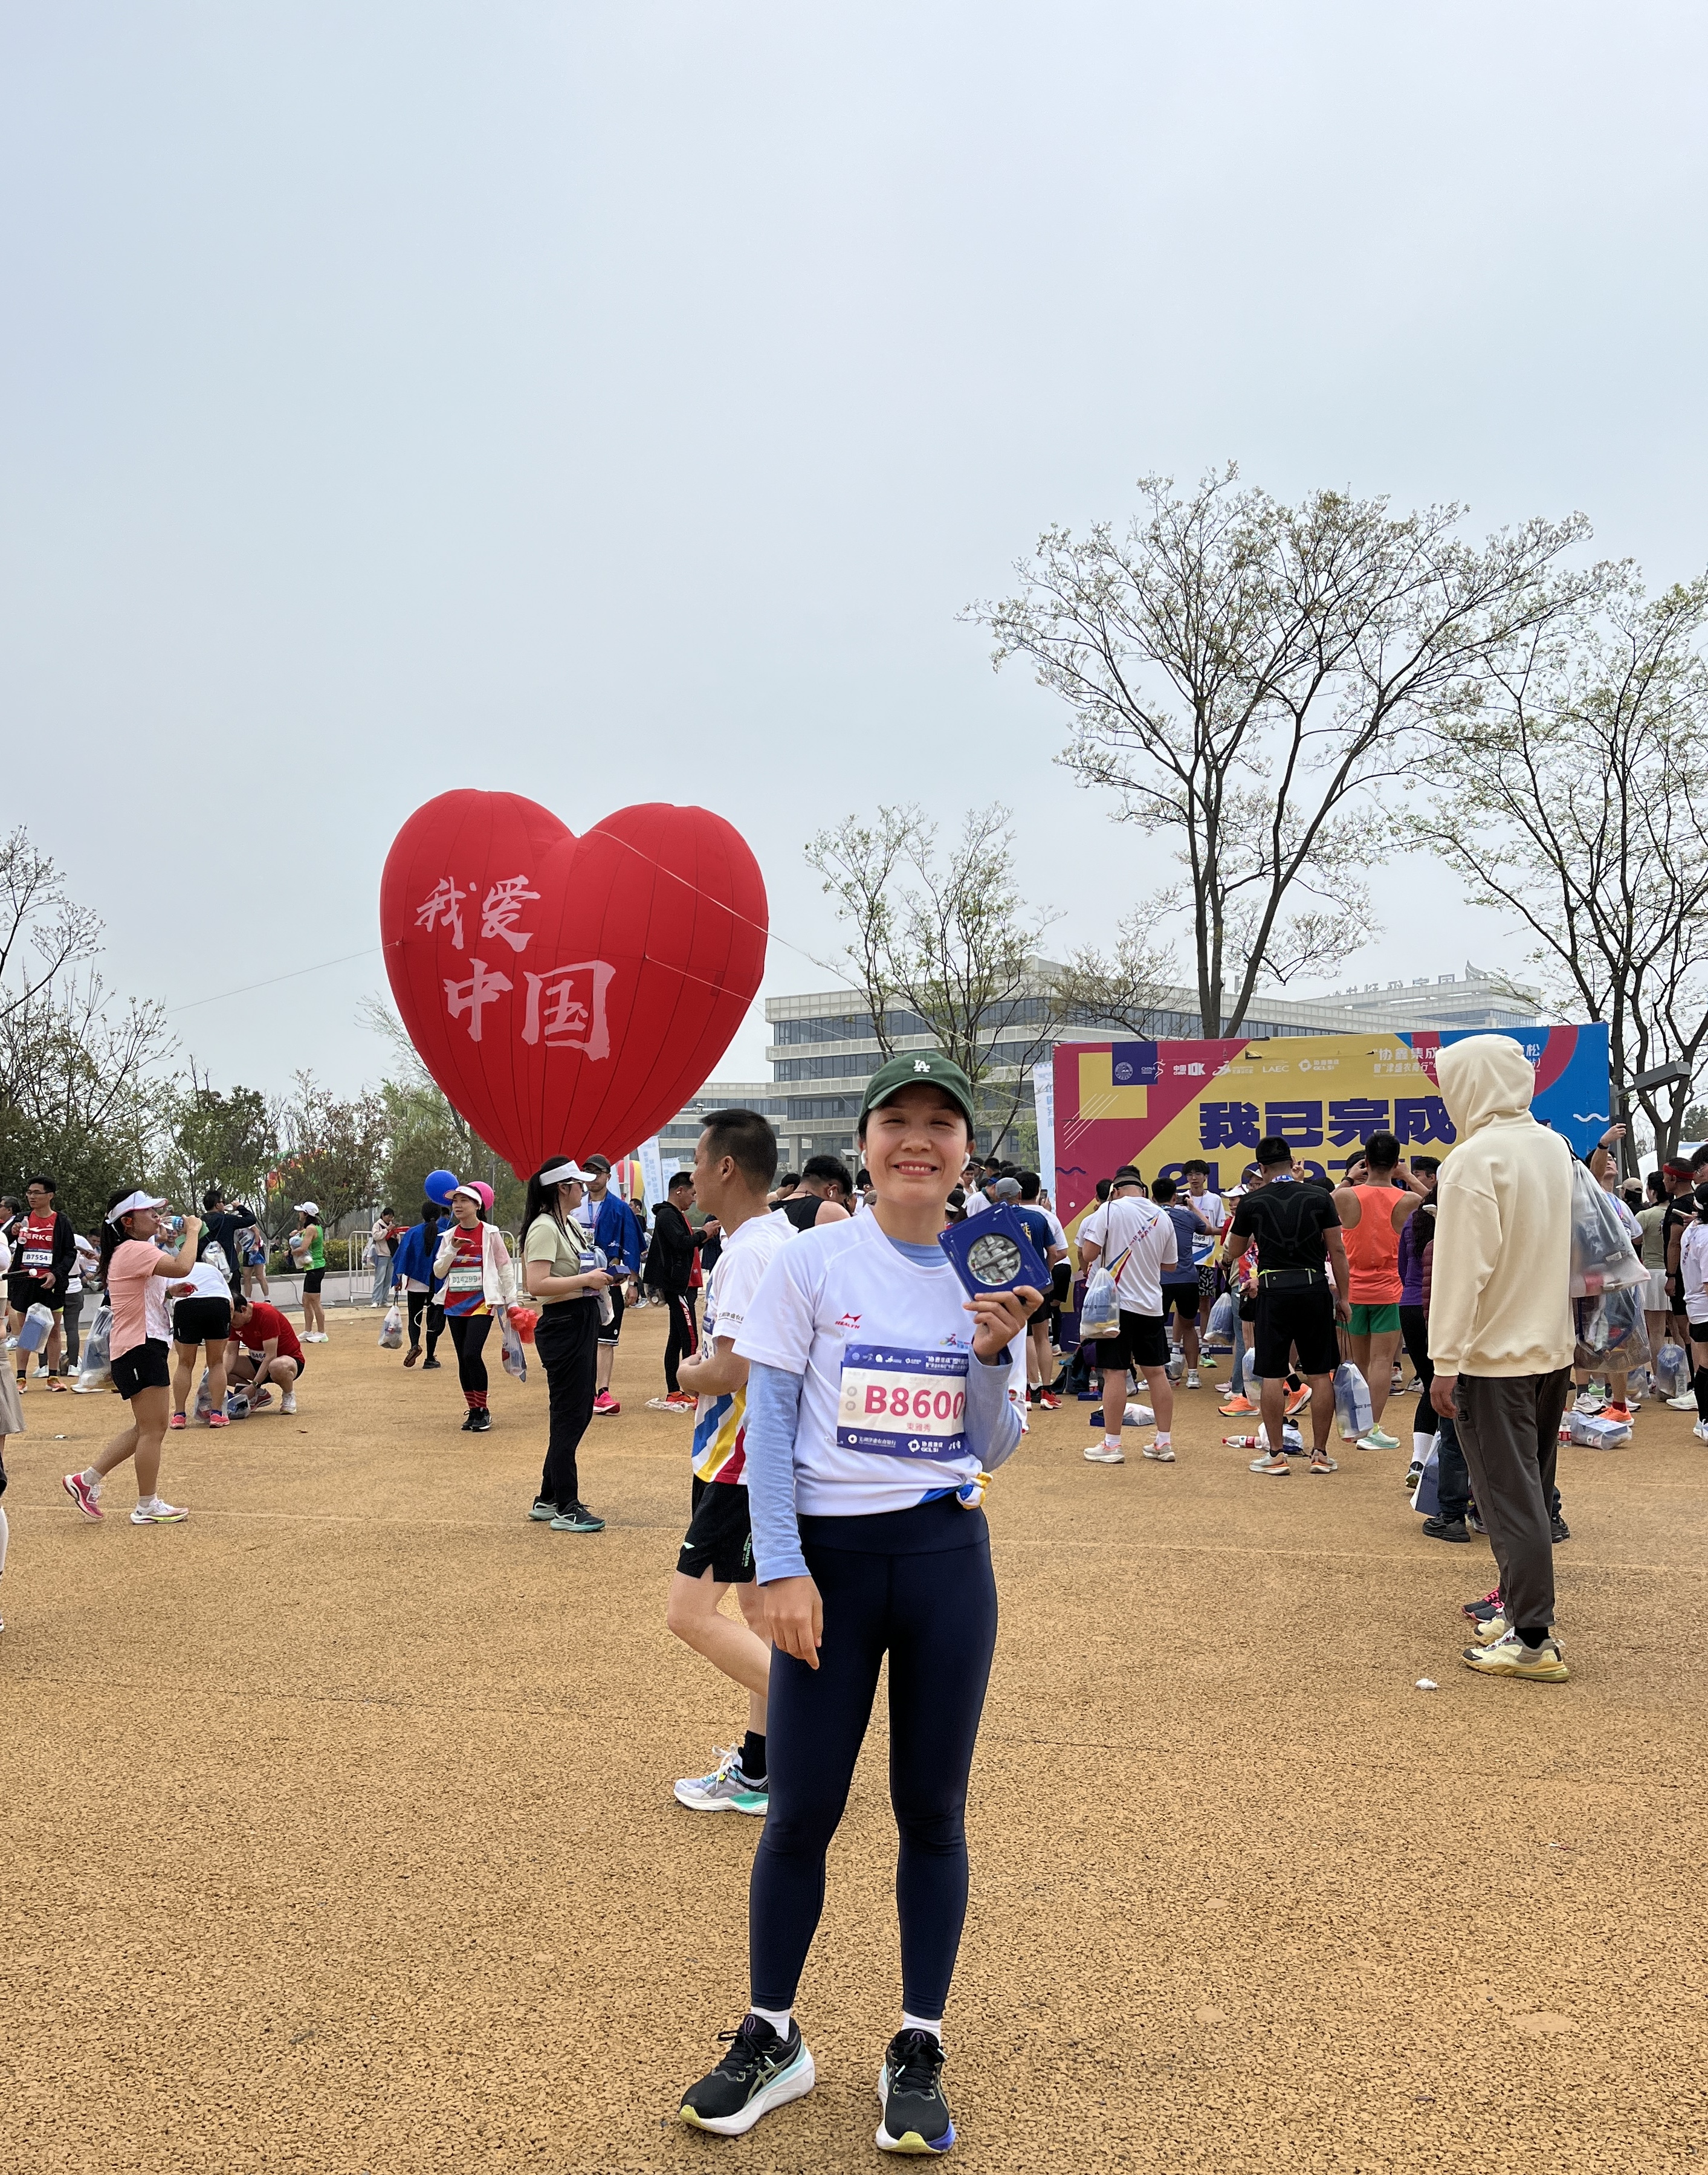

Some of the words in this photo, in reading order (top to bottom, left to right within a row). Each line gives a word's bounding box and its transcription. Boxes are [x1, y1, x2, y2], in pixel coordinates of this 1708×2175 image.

[414, 874, 541, 952] 我爱
[443, 958, 616, 1061] 中国
[913, 1059, 931, 1073] LA
[1199, 1095, 1457, 1151] 我已完成
[26, 1233, 53, 1241] ERKE
[865, 1385, 965, 1420] B8600
